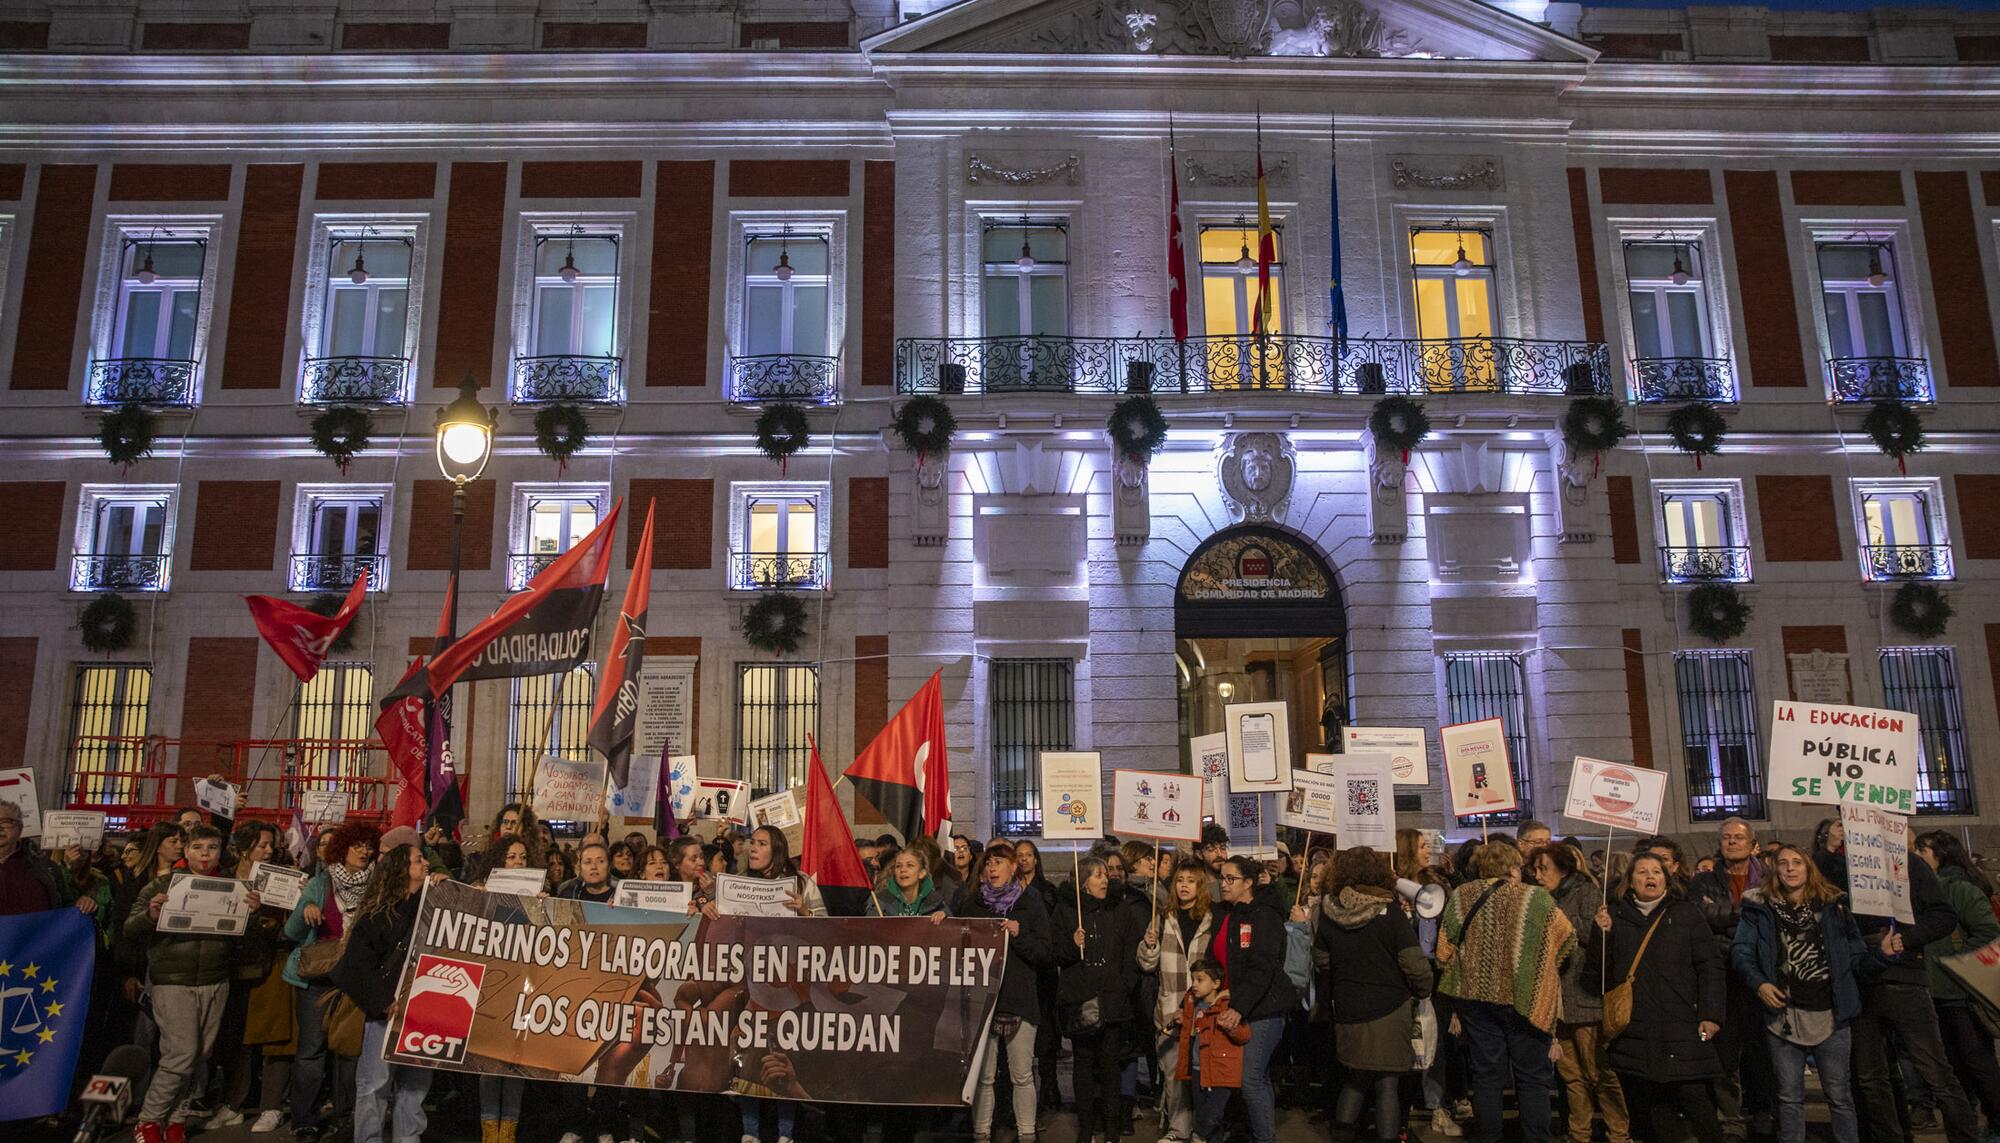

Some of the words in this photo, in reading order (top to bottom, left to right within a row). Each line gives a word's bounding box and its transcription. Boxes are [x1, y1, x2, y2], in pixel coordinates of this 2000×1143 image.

[1195, 589, 1259, 599] COMUNIDAD
[1261, 589, 1276, 598] DE
[1278, 589, 1320, 598] MADRID
[1223, 579, 1291, 587] PRESIDENCIA
[1778, 706, 1795, 722] LA
[1810, 709, 1904, 733] EDUCACIÓN
[1802, 736, 1897, 766] PÚBLICA
[1294, 777, 1319, 786] AREMACIÓN
[1827, 761, 1864, 780] NO
[1791, 776, 1822, 796] SE
[1834, 779, 1912, 811] VENDE
[546, 800, 600, 815] ABANDON
[729, 883, 751, 891] ¿Quién
[752, 885, 774, 893] piensa
[426, 907, 571, 969] INTERINOS
[578, 930, 595, 970] Y
[600, 932, 745, 983] LABORALES
[752, 944, 788, 984] EN
[796, 945, 901, 985] FRAUDE
[908, 945, 941, 986] DE
[949, 947, 997, 987] LEY
[512, 992, 570, 1037] LOS
[575, 999, 635, 1045] QUE
[641, 998, 730, 1048] ESTÁN
[737, 1009, 768, 1049] SE
[776, 1010, 901, 1053] QUEDAN
[403, 1031, 463, 1059] CGT
